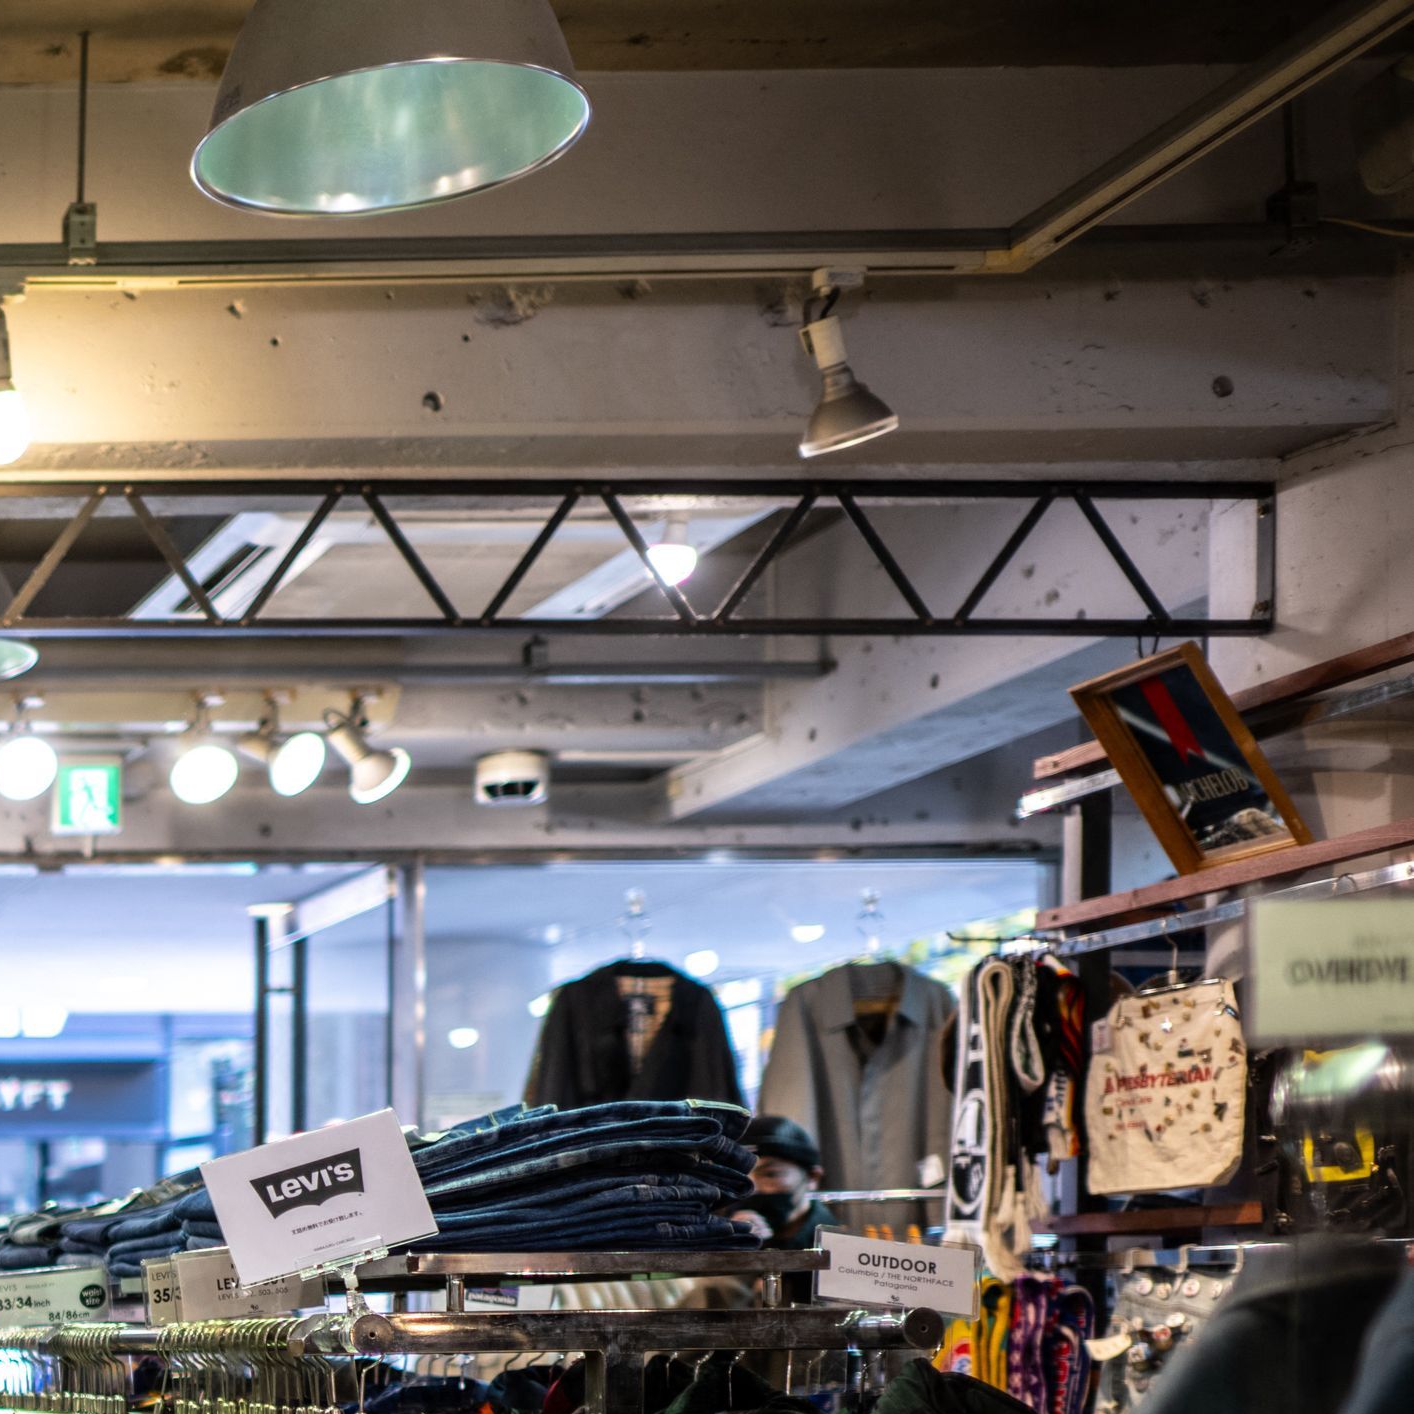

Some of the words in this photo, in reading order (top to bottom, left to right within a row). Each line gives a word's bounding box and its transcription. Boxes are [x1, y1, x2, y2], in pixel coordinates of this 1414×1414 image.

[858, 1253, 937, 1275] OUTDOOR
[838, 1266, 879, 1278] Columbia
[887, 1272, 901, 1281] THE
[874, 1279, 918, 1292] Patagonia
